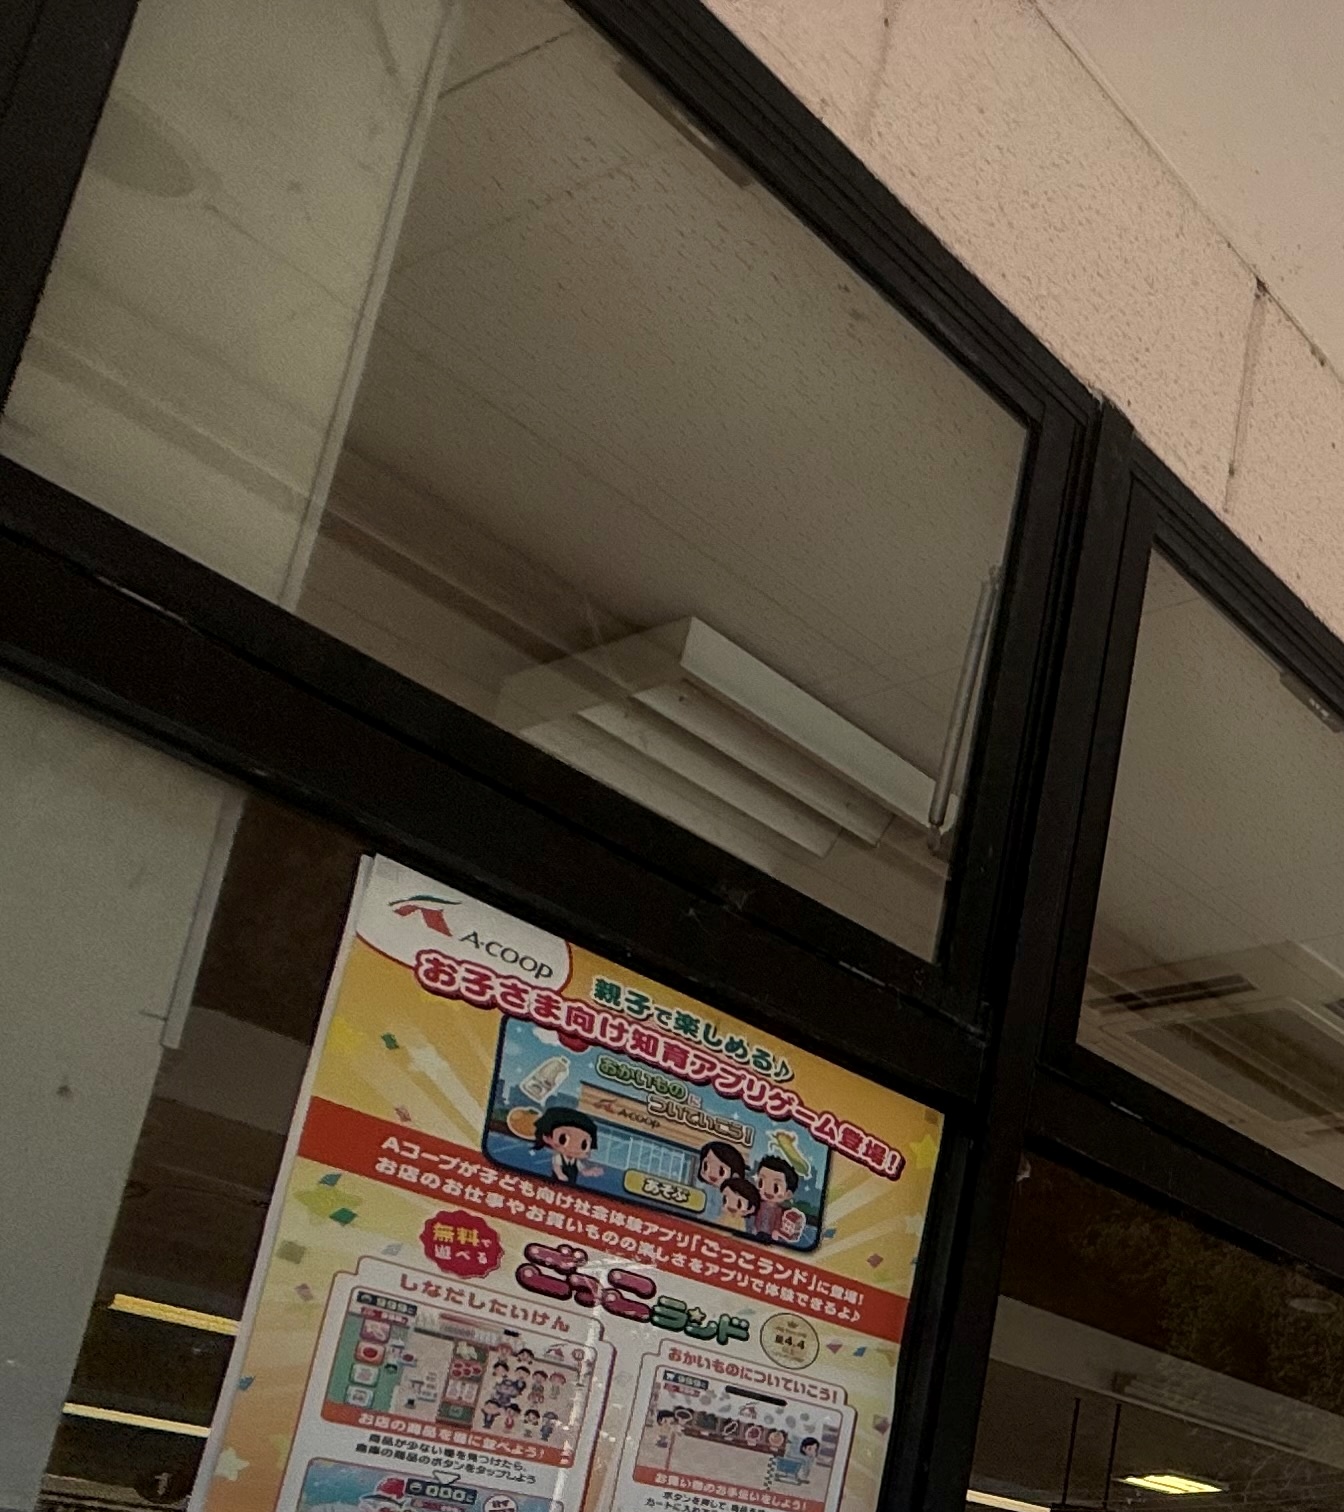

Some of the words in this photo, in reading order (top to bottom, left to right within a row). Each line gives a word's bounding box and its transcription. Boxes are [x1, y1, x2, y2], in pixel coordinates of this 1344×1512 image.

[641, 1178, 691, 1204] あそぶ
[400, 1273, 571, 1333] しなだしたいけん
[667, 1346, 839, 1402] おかいものについていこう!
